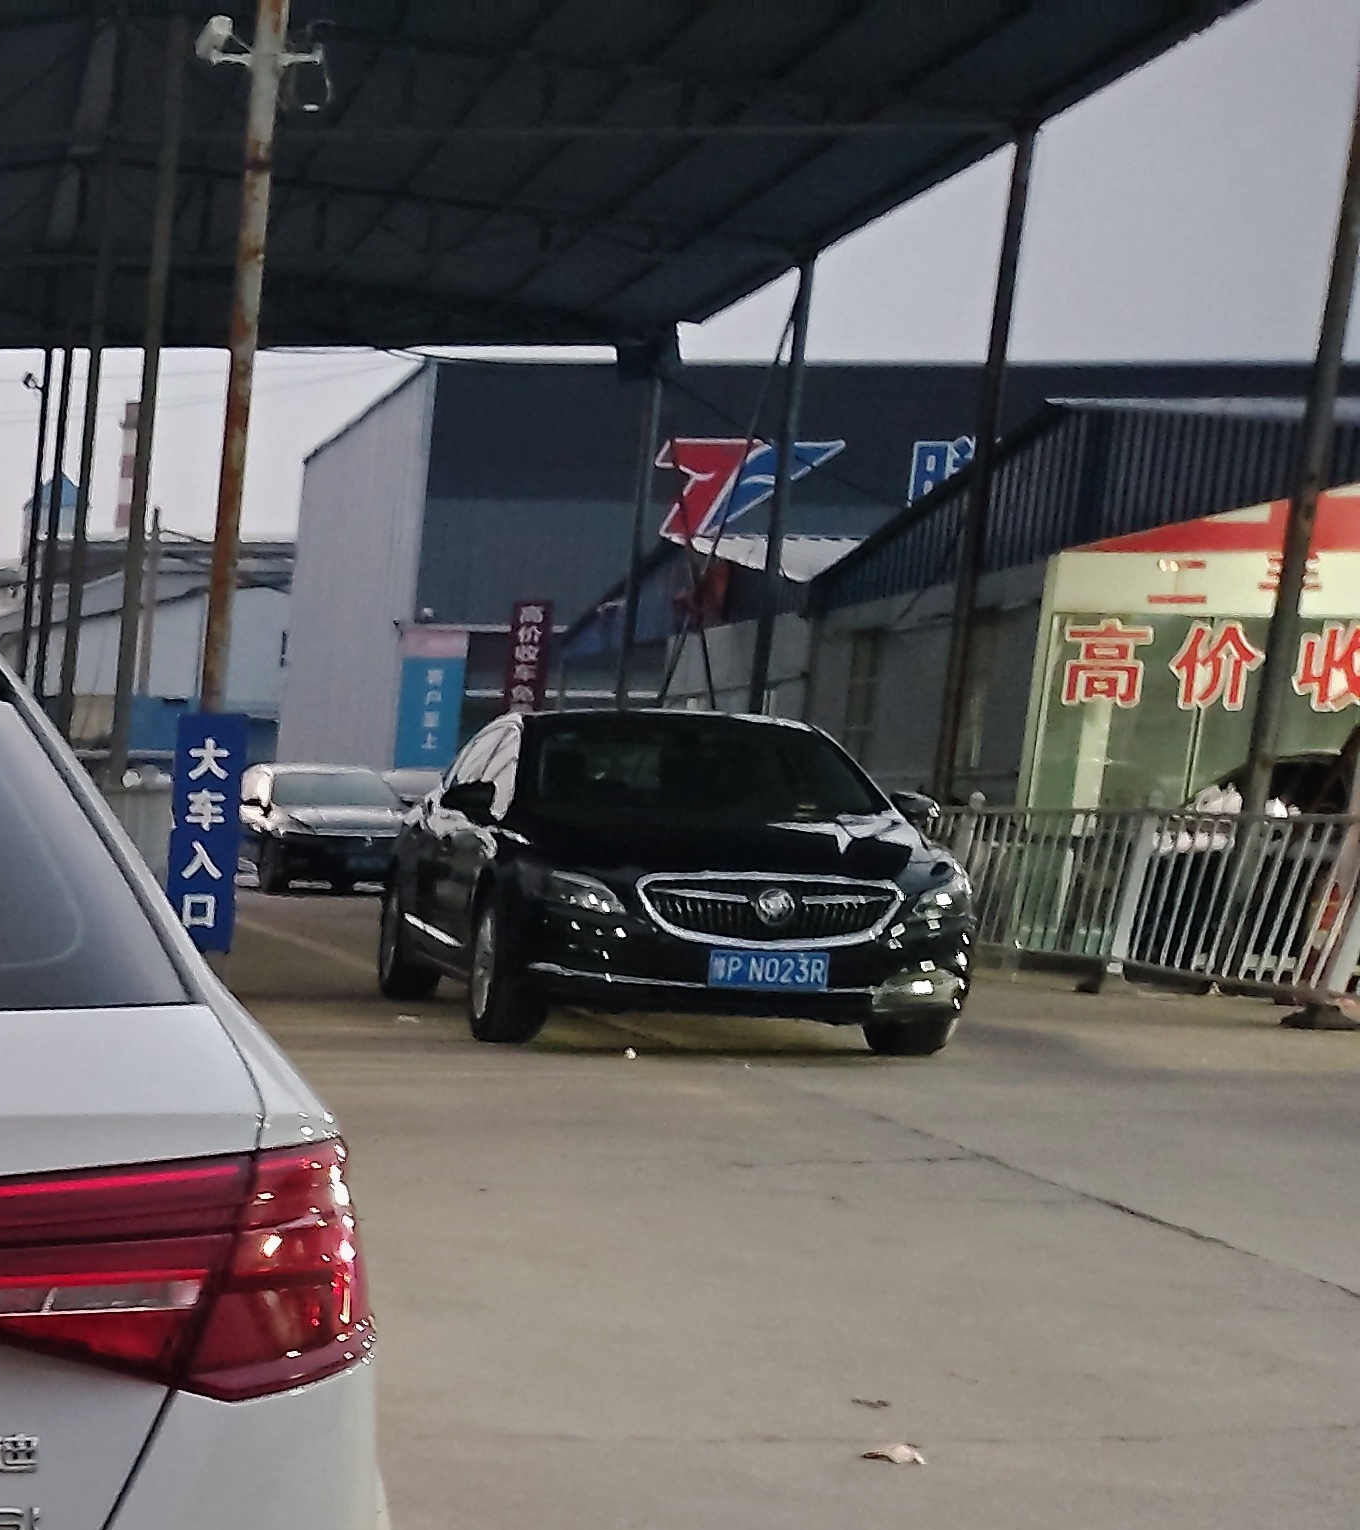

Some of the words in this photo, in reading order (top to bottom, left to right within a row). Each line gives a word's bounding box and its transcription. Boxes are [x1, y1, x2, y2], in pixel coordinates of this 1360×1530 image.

[181, 736, 230, 928] 大车入口
[748, 957, 825, 983] N023R
